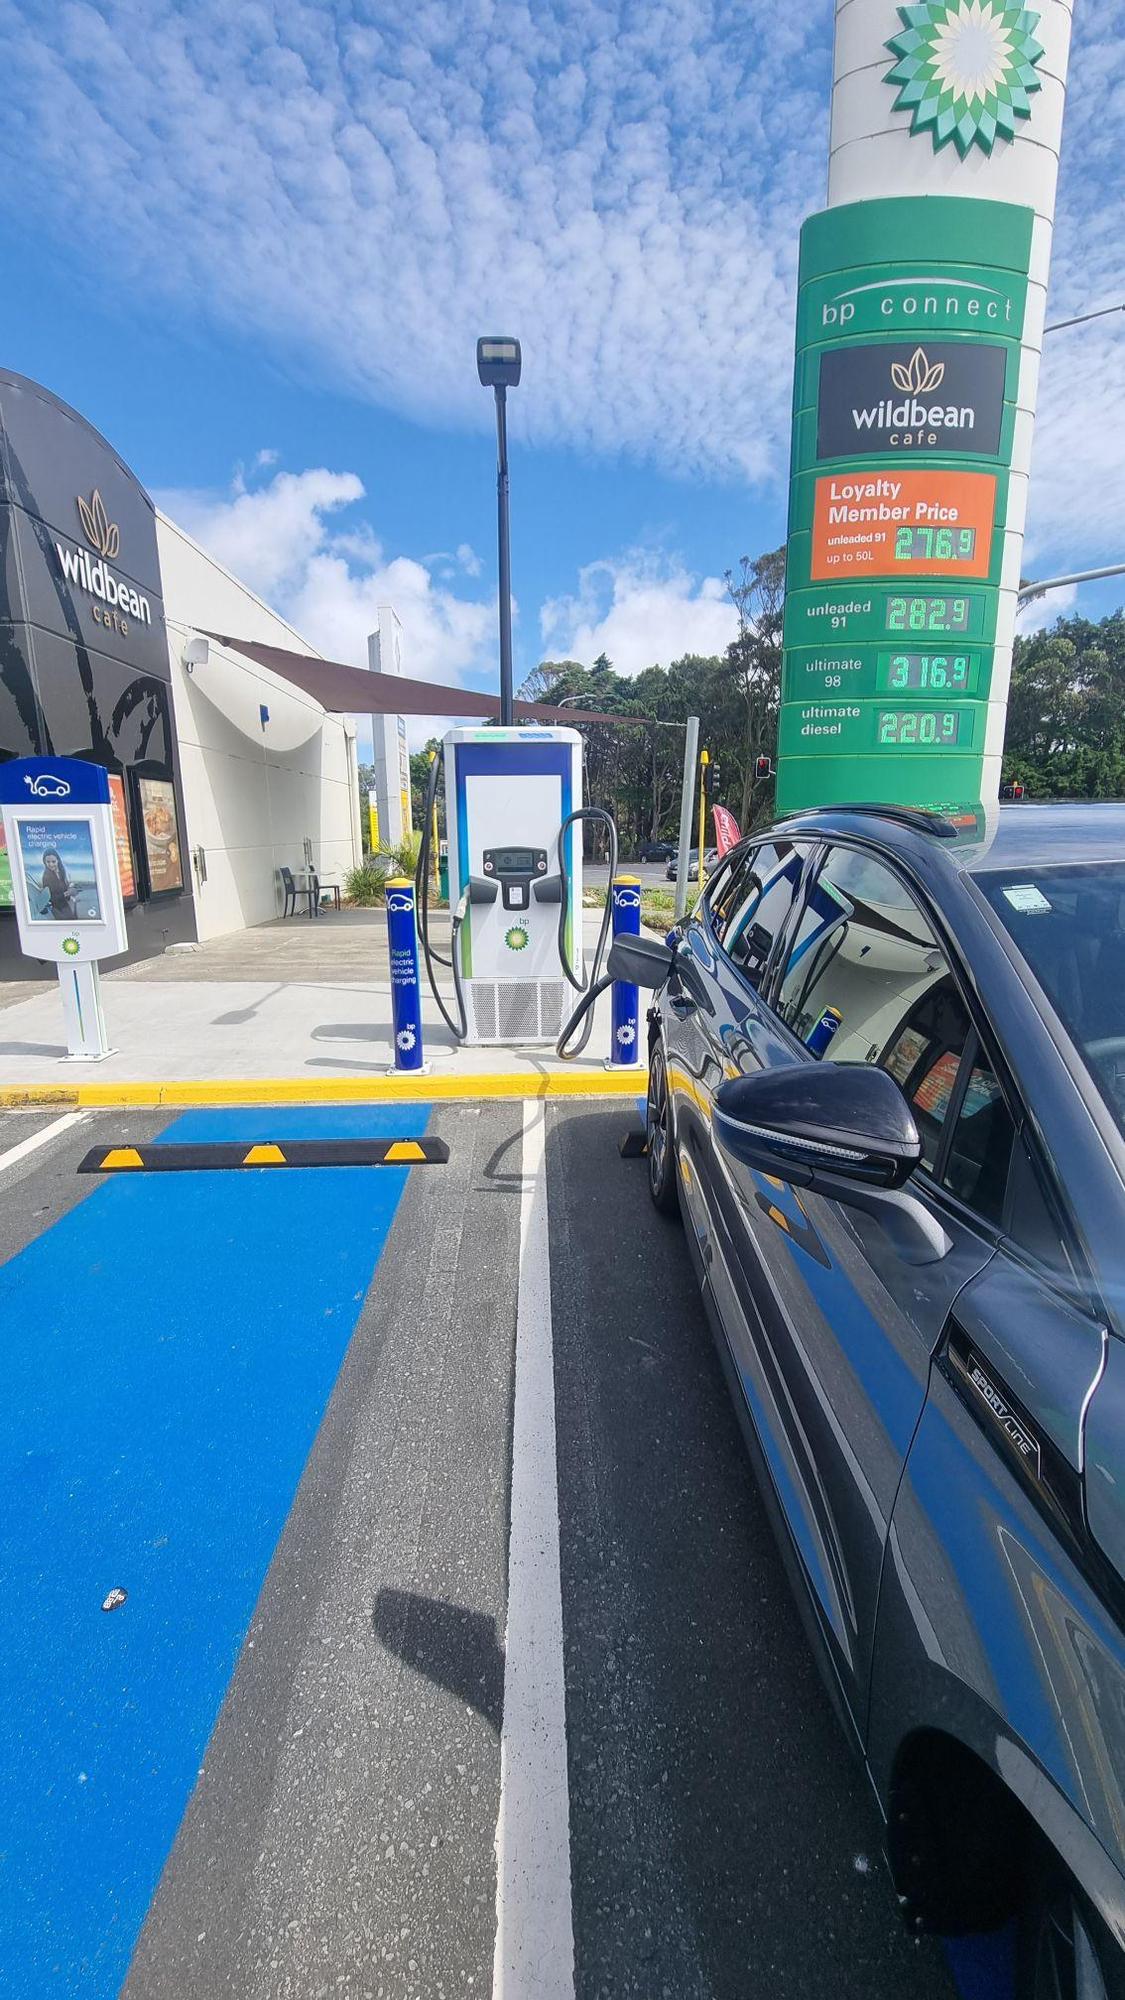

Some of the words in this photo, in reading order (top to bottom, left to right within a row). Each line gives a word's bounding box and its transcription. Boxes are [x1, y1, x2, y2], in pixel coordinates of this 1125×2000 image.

[822, 302, 855, 326] bp
[881, 296, 1013, 321] connect
[852, 399, 976, 430] wildbean
[889, 429, 937, 445] cafe
[830, 478, 902, 503] Loyalty
[828, 502, 911, 524] Member
[915, 501, 959, 521] Price
[827, 533, 873, 546] unleaded
[874, 532, 886, 543] 91
[894, 527, 974, 561] 276.9
[826, 554, 840, 565] up
[842, 552, 853, 562] to
[855, 551, 874, 561] 50L
[56, 543, 151, 625] wildbean
[806, 601, 872, 617] unleaded
[889, 598, 965, 631] 282.9
[92, 604, 128, 636] cafe
[831, 616, 847, 629] 91
[806, 658, 862, 672] ultimate
[891, 656, 966, 689] 316.9
[824, 675, 841, 688] 98
[801, 705, 861, 719] ultimate
[801, 722, 841, 736] diesel
[880, 712, 955, 744] 220.9
[26, 825, 46, 834] Rapid
[53, 832, 77, 840] vehicle
[28, 840, 57, 848] charging
[519, 917, 529, 926] bp
[391, 949, 411, 957] Rapid
[971, 1368, 1008, 1415] SPORT
[1004, 1421, 1031, 1455] LINE
